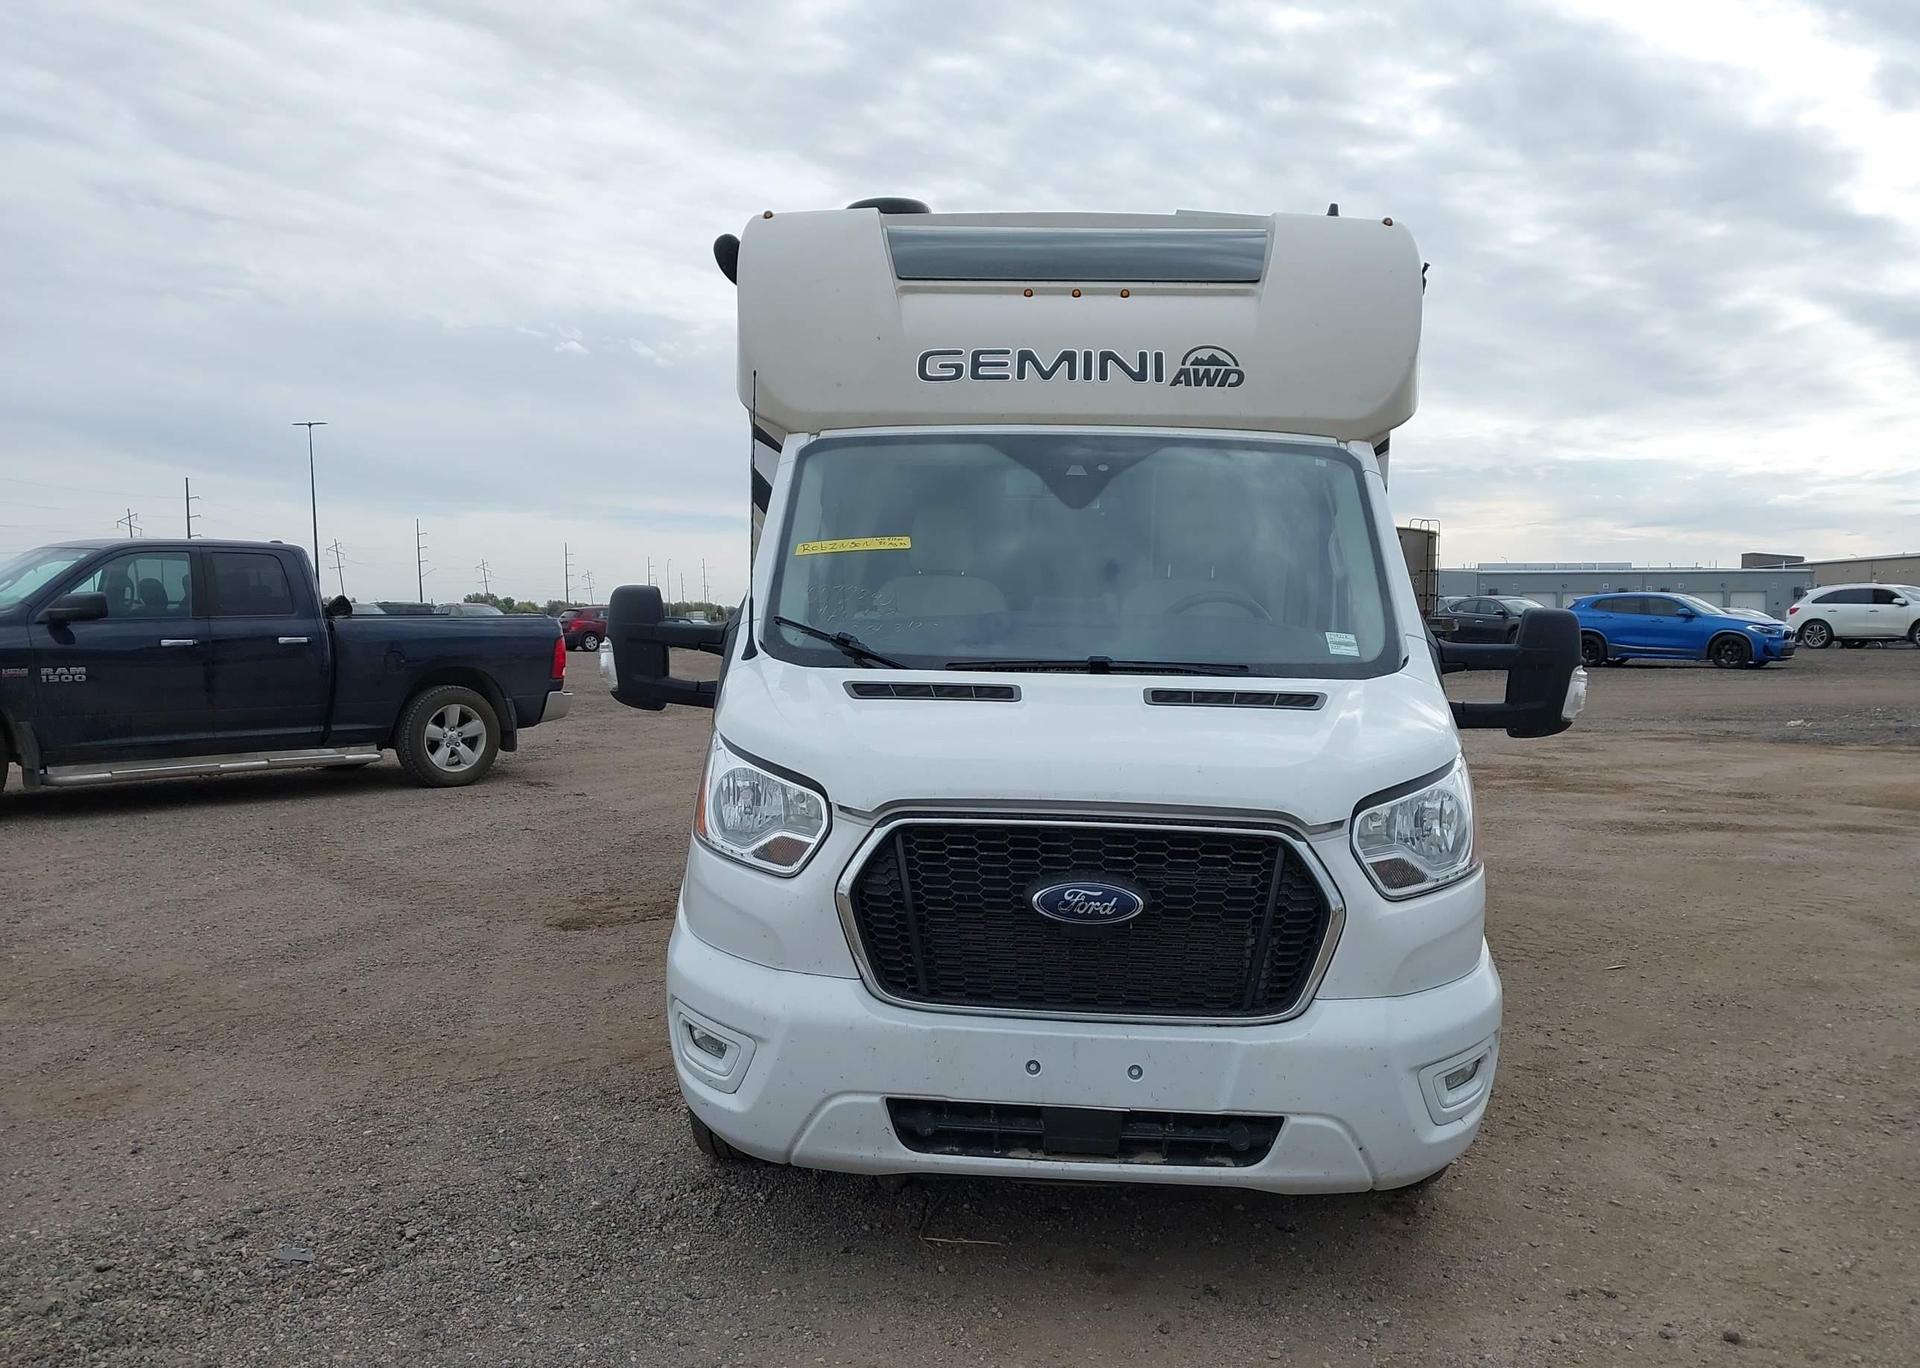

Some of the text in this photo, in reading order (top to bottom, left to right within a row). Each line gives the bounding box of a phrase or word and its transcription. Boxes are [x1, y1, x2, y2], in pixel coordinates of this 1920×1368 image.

[916, 348, 1245, 388] GEMINI AWD
[40, 666, 87, 675] RAM
[40, 674, 87, 683] 1500
[1057, 888, 1118, 915] Ford
